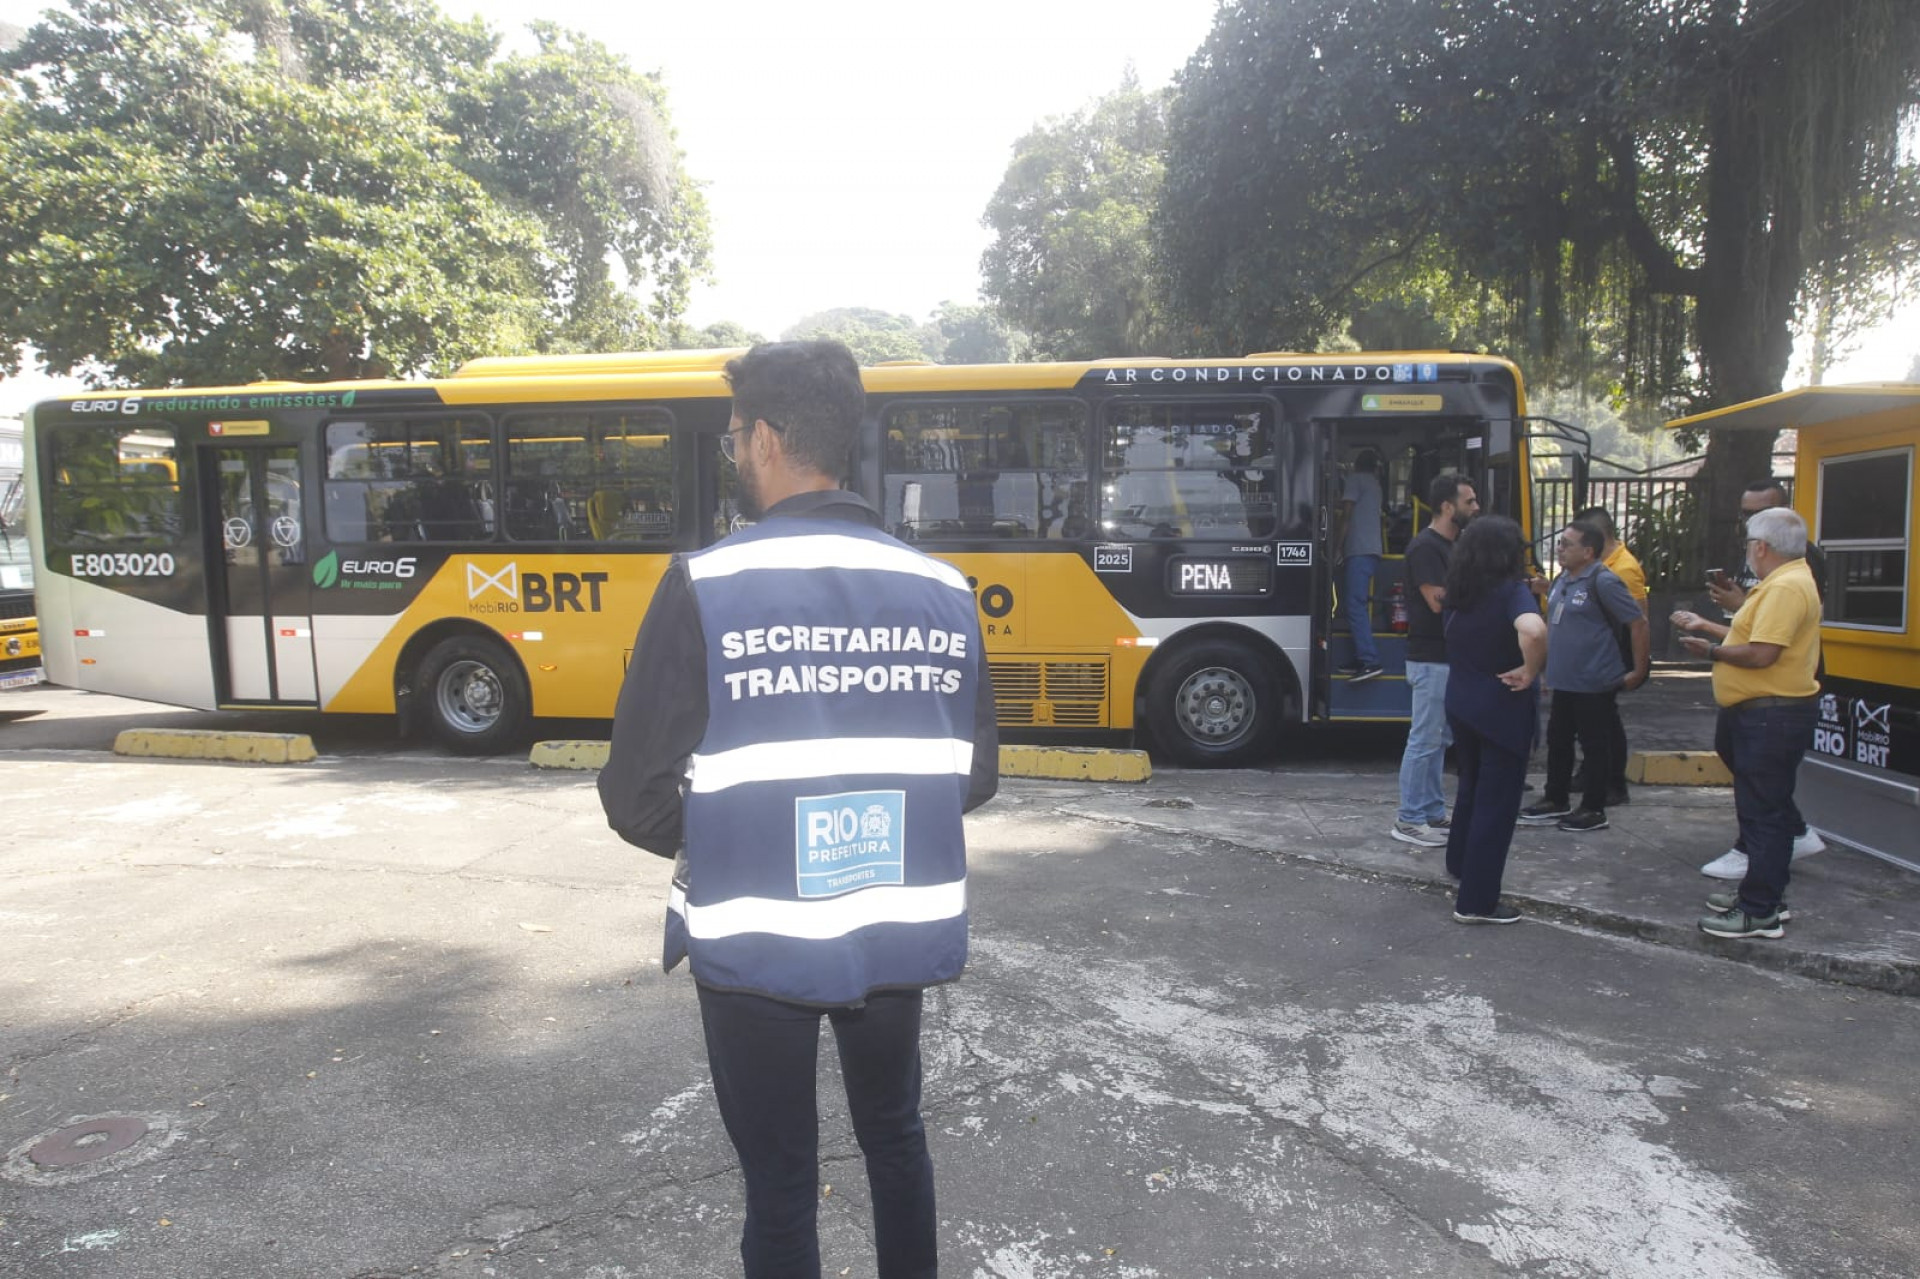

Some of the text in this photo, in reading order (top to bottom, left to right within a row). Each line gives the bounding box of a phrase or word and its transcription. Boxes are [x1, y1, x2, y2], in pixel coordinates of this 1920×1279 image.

[1105, 366, 1390, 381] AR CONDICIONADO
[71, 391, 337, 414] EURO 6 reduzindo emissões
[1098, 554, 1129, 565] 2025
[1280, 547, 1306, 558] 1746
[71, 553, 175, 576] E803020
[1181, 564, 1232, 590] PENA
[521, 572, 608, 612] BRT
[469, 602, 519, 613] MobiRIO
[721, 625, 967, 659] SECRETARIA DE
[724, 665, 963, 700] TRANSPORTES
[1814, 728, 1845, 756] RIO
[1857, 740, 1890, 768] BRT
[808, 807, 858, 847] RIO
[808, 840, 891, 863] PREFEITURA
[827, 869, 876, 888] TRANSPORTES
